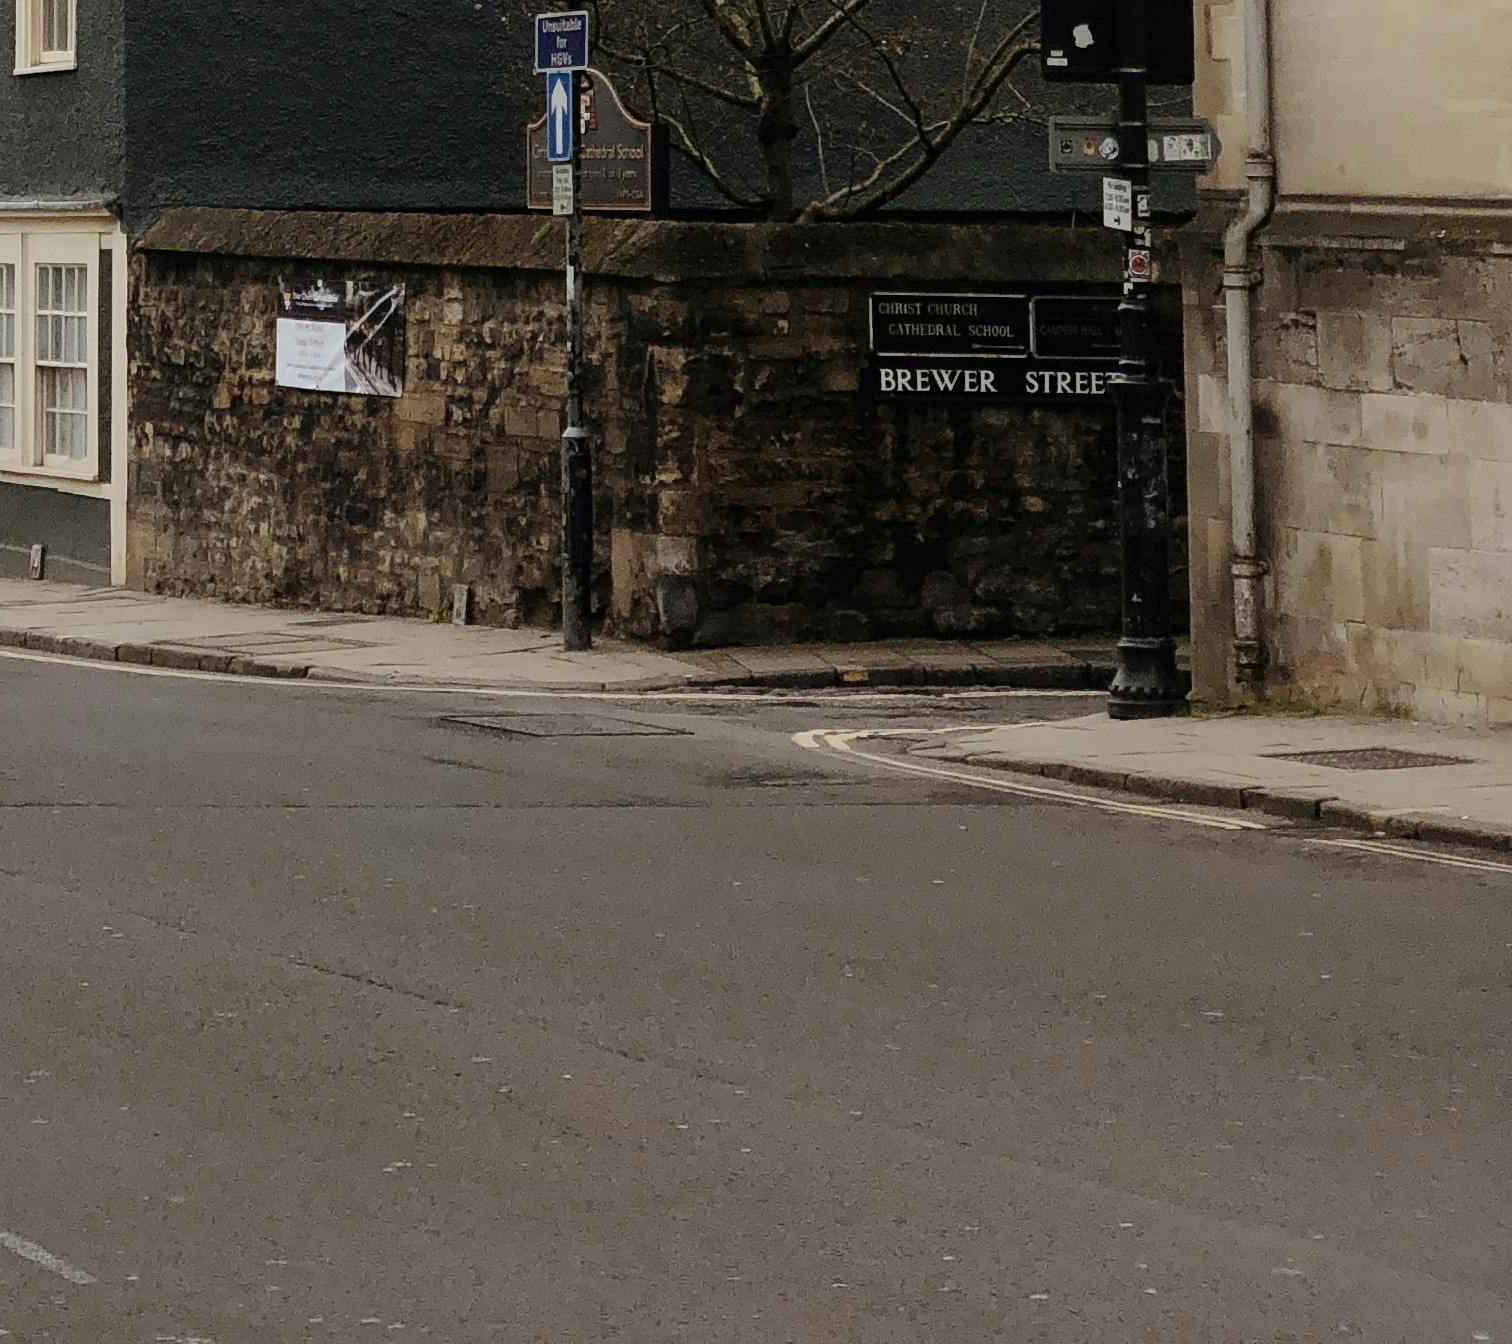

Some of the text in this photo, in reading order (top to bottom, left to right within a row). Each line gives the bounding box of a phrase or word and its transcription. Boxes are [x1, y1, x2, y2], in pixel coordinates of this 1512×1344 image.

[542, 17, 582, 33] Unsuitable
[556, 35, 568, 49] for
[550, 51, 573, 66] HGVs
[878, 303, 978, 316] CHRIST CHURCH
[888, 323, 1015, 338] CATHEDRAL SCHOOL
[879, 368, 999, 393] BREWER
